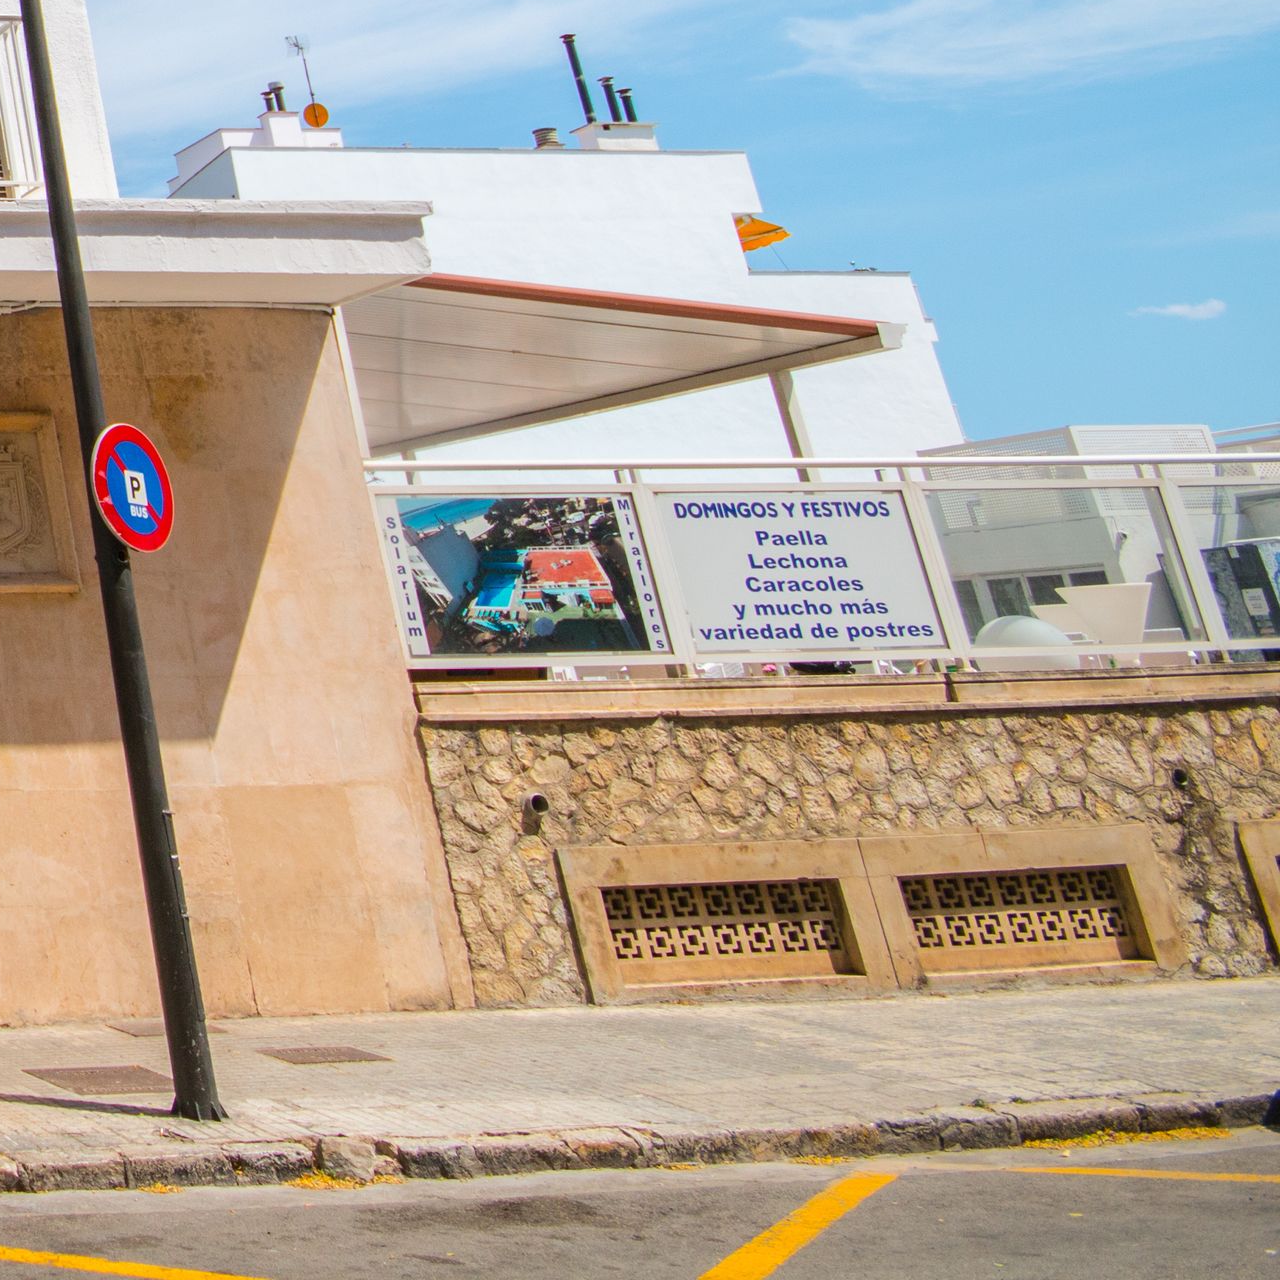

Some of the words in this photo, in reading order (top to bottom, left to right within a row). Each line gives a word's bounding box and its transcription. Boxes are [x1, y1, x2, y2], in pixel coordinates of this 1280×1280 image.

[129, 476, 141, 499] P
[130, 504, 149, 520] BUS
[673, 501, 778, 519] DOMINGOS
[781, 502, 795, 518] Y
[800, 500, 890, 518] FESTIVOS
[754, 530, 828, 546] Paella
[747, 553, 848, 569] Lechona
[386, 517, 422, 637] Solarium
[617, 499, 665, 649] Miraflores
[745, 576, 864, 592] Caracoles
[732, 604, 746, 620] y
[754, 600, 832, 616] mucho
[840, 598, 889, 615] más
[699, 623, 803, 640] variedad
[810, 622, 839, 639] de
[845, 622, 934, 642] postres
